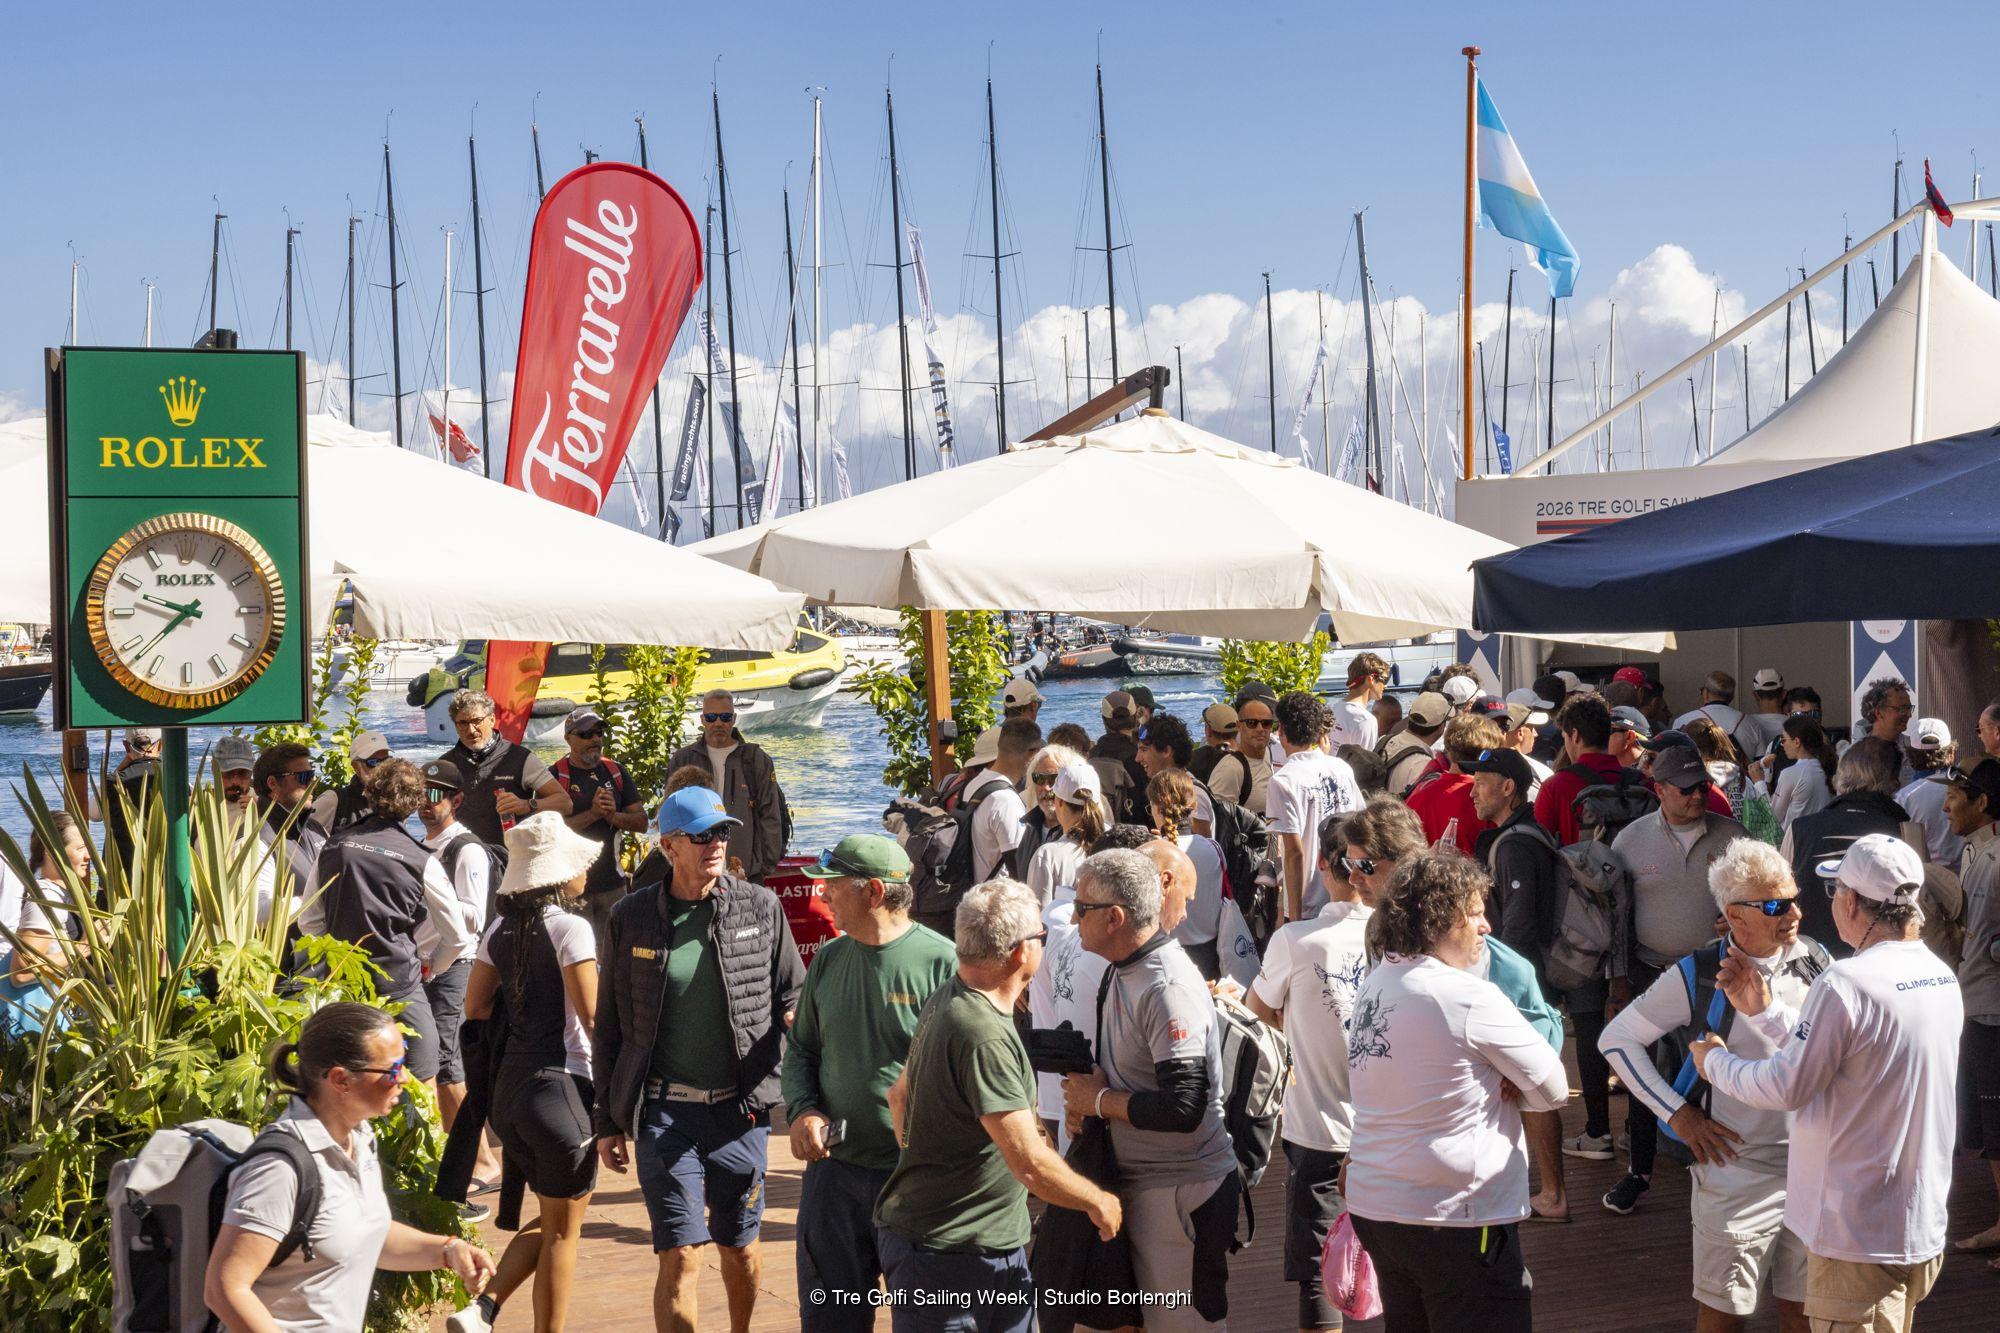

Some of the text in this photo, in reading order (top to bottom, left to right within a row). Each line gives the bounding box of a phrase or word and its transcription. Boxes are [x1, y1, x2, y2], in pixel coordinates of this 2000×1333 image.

[521, 199, 638, 518] Ferrarelle
[680, 399, 701, 484] racing-yachts.com
[98, 436, 268, 469] ROLEX
[1536, 501, 1574, 516] 2026
[1578, 501, 1607, 515] TRE
[1611, 499, 1656, 514] GOLFI
[156, 573, 216, 586] ROLEX
[771, 883, 825, 898] LASTIC
[735, 926, 760, 939] MUSTO
[797, 933, 828, 956] arell
